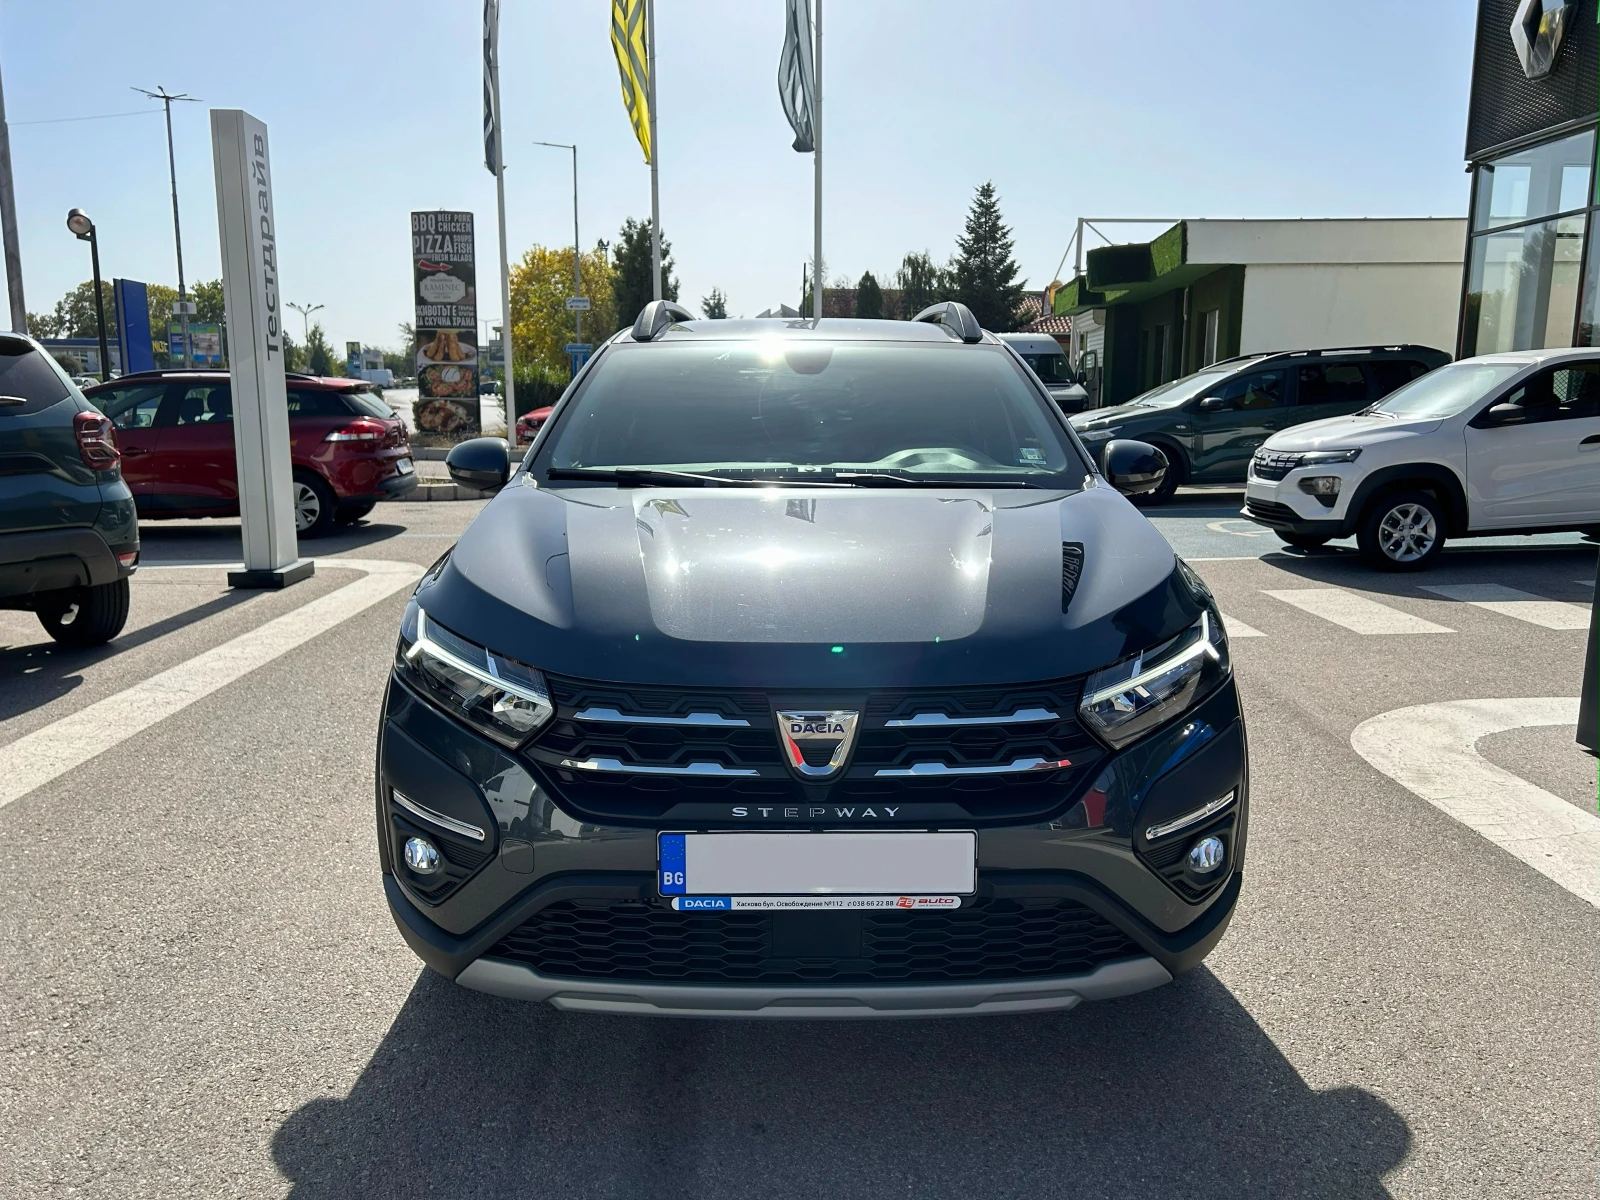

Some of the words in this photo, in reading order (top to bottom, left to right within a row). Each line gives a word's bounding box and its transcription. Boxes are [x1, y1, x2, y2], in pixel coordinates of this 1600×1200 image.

[437, 213, 452, 222] BEEF
[453, 214, 472, 222] PORK
[412, 213, 436, 234] BBQ
[437, 222, 472, 232] CHICKEN
[252, 133, 279, 361] Тестдрайв
[412, 234, 453, 254] PIZZA
[453, 243, 472, 254] FISH
[431, 253, 449, 262] FRESH
[449, 253, 473, 262] SALADS
[424, 283, 462, 292] KAMENEC
[424, 316, 452, 327] СКУЧНА
[452, 316, 476, 327] ХРАНА
[790, 723, 845, 734] DACIA
[731, 806, 900, 818] STEPWAY
[663, 871, 684, 886] BG
[684, 899, 725, 908] DACIA
[762, 900, 776, 909] бул.
[776, 900, 823, 908] Освобождение
